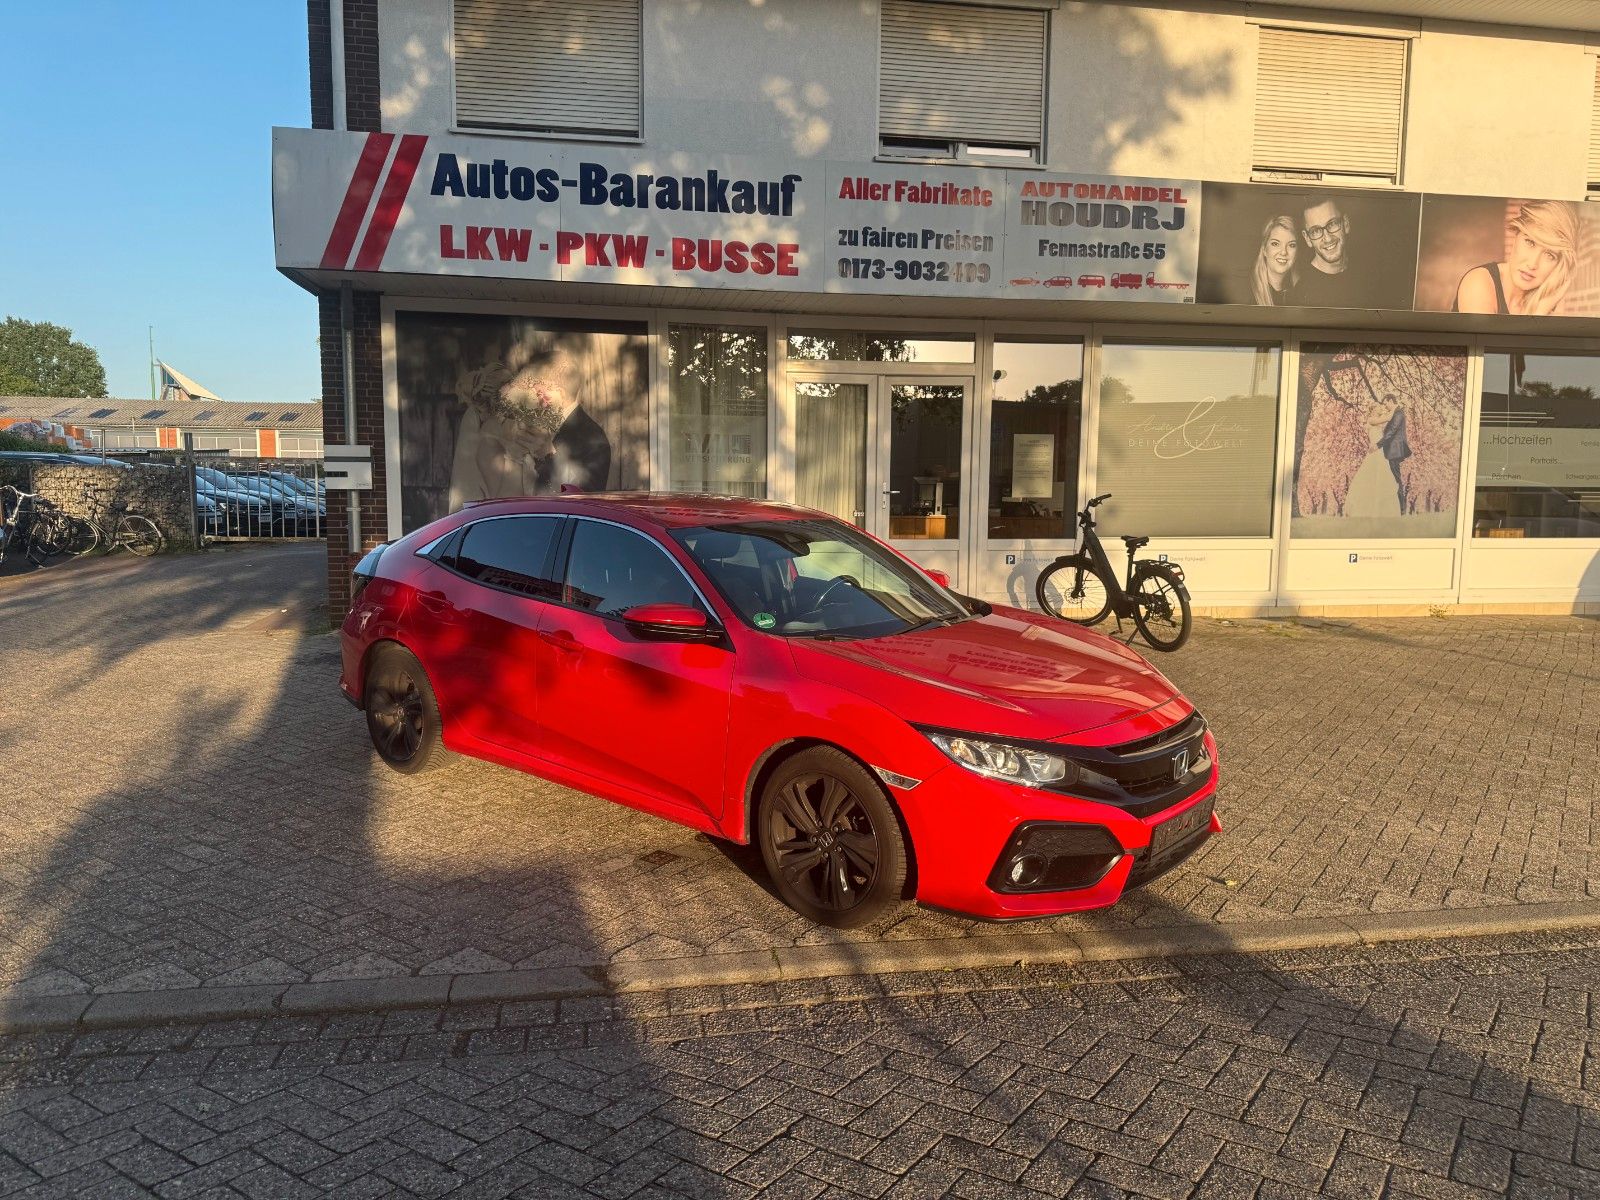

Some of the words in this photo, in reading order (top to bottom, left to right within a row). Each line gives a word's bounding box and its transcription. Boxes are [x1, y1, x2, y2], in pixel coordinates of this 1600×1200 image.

[430, 152, 802, 217] Autos-Barankauf
[838, 176, 891, 201] Aller
[895, 180, 993, 207] Fabrikate
[1020, 181, 1188, 203] AUTOHANDEL
[1020, 200, 1186, 231] HOUDRJ
[439, 224, 533, 263] LKW
[556, 231, 649, 269] PKW
[672, 237, 799, 277] BUSSE
[838, 229, 859, 247] zu
[861, 226, 919, 249] fairen
[921, 228, 994, 252] Preisen
[1038, 239, 1140, 260] Fennastraße
[1142, 243, 1166, 260] 55
